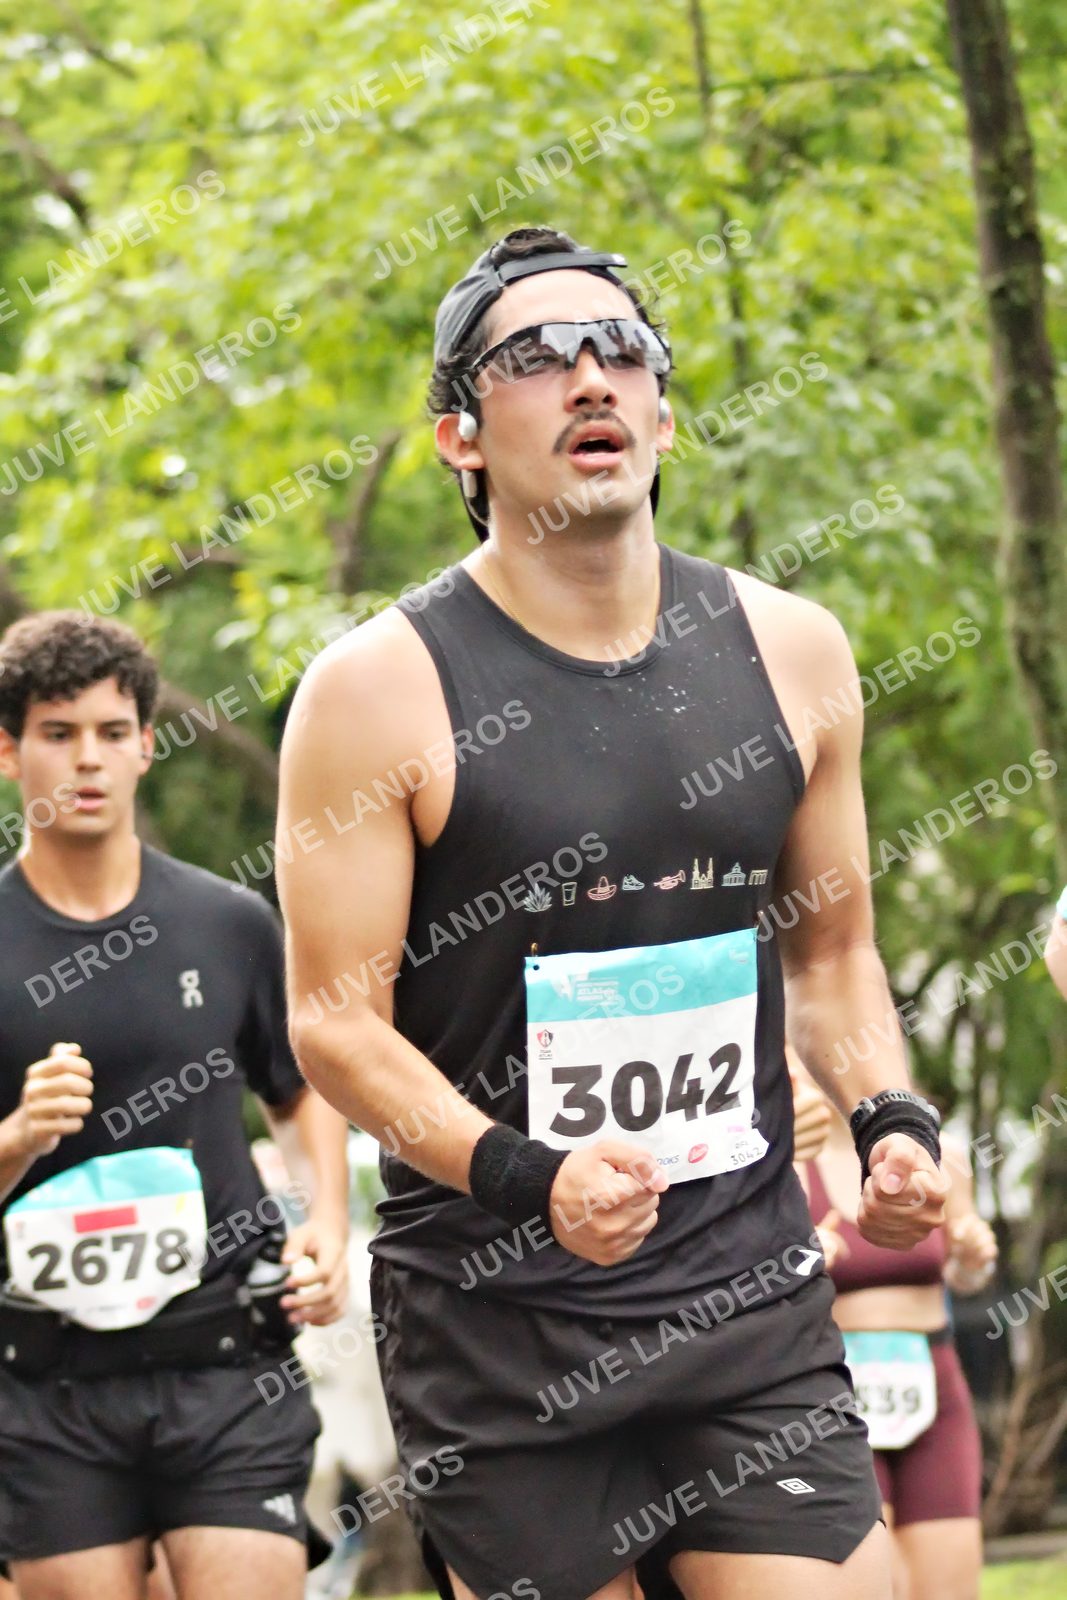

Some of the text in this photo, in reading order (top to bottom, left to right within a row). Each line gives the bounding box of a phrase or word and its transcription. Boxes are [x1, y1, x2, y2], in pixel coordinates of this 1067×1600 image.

[549, 1043, 742, 1137] 3042
[731, 1146, 763, 1166] 3042
[28, 1228, 187, 1291] 2678
